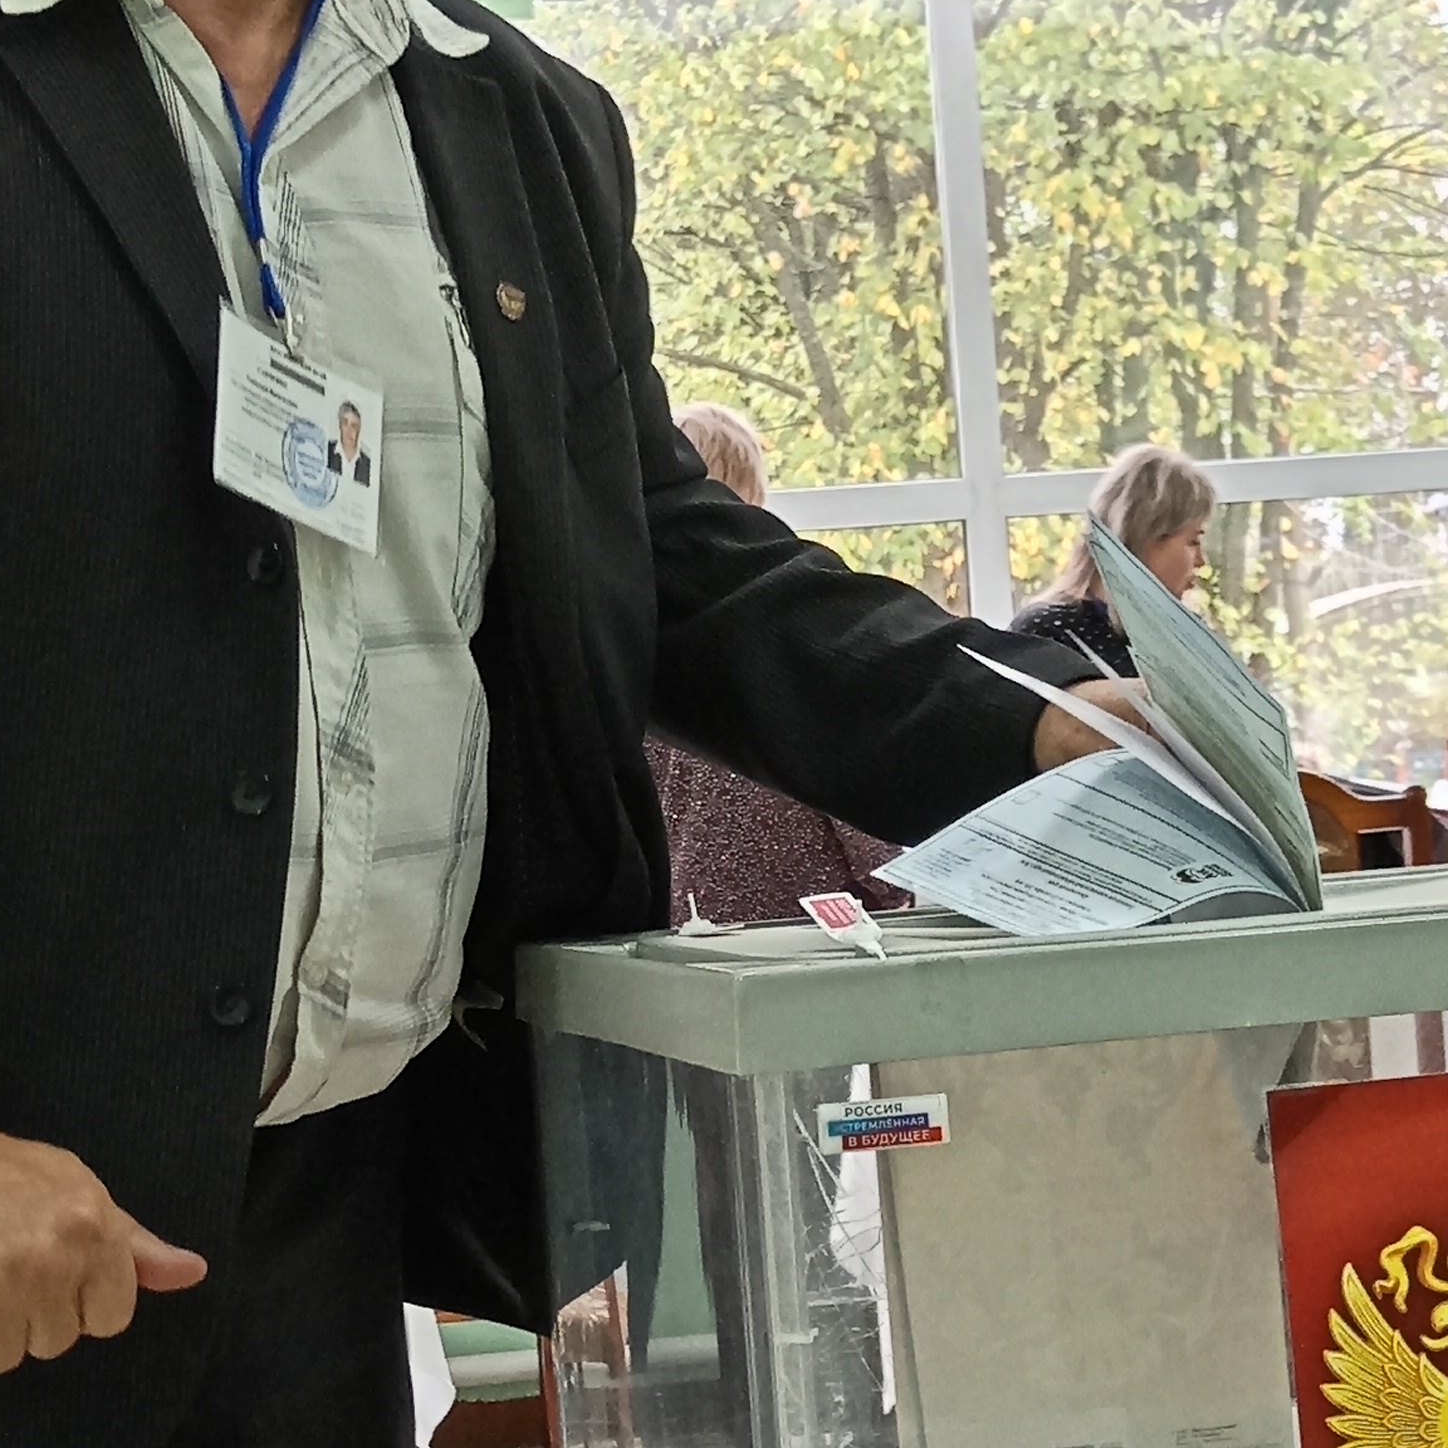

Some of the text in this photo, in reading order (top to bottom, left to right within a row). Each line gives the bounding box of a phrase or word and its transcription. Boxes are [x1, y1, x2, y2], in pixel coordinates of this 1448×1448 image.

[844, 1102, 903, 1118] РОССИЯ
[848, 1129, 931, 1147] В БУДУЩЕЕ
